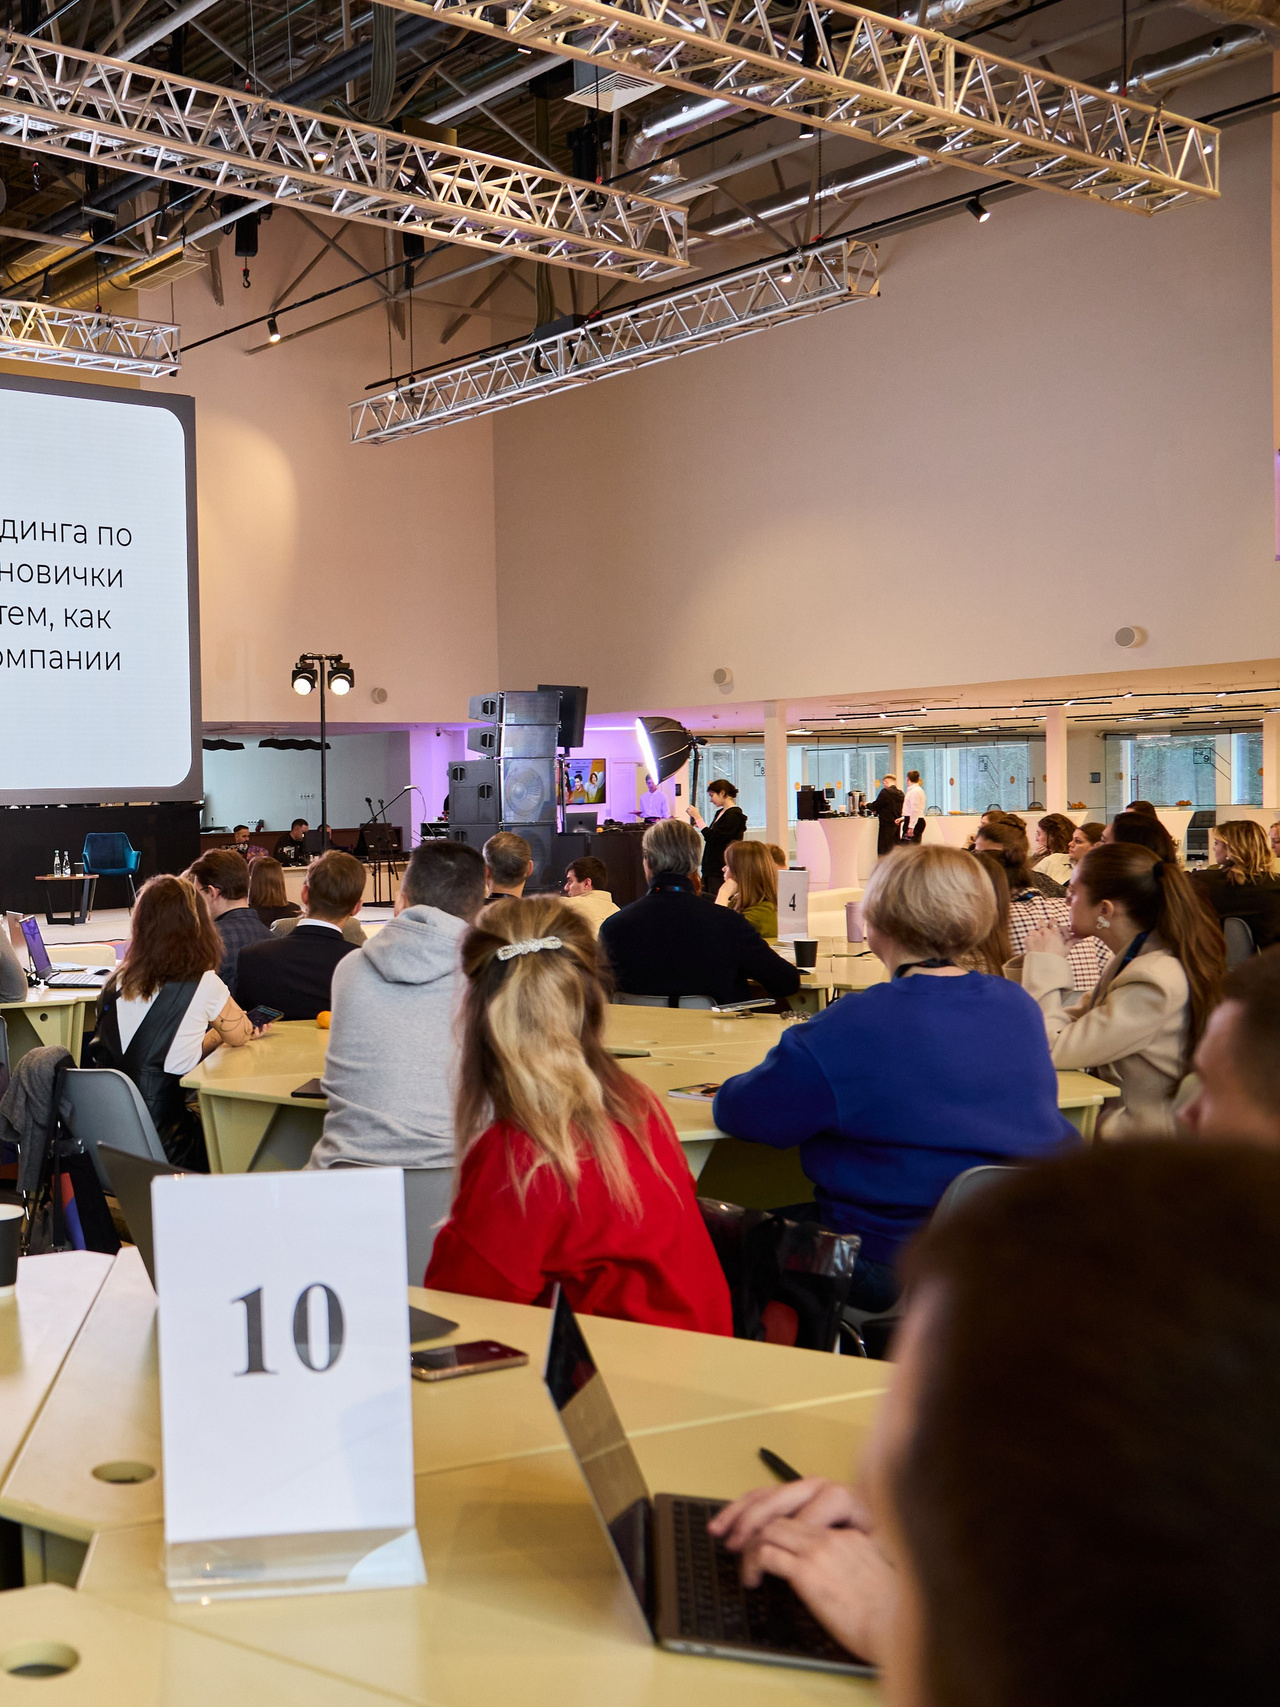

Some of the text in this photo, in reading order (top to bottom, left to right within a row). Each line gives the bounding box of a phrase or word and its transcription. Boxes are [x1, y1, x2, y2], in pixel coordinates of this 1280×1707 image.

[98, 525, 132, 547] по
[64, 607, 112, 630] как
[788, 892, 797, 912] 4
[229, 1282, 347, 1378] 10
